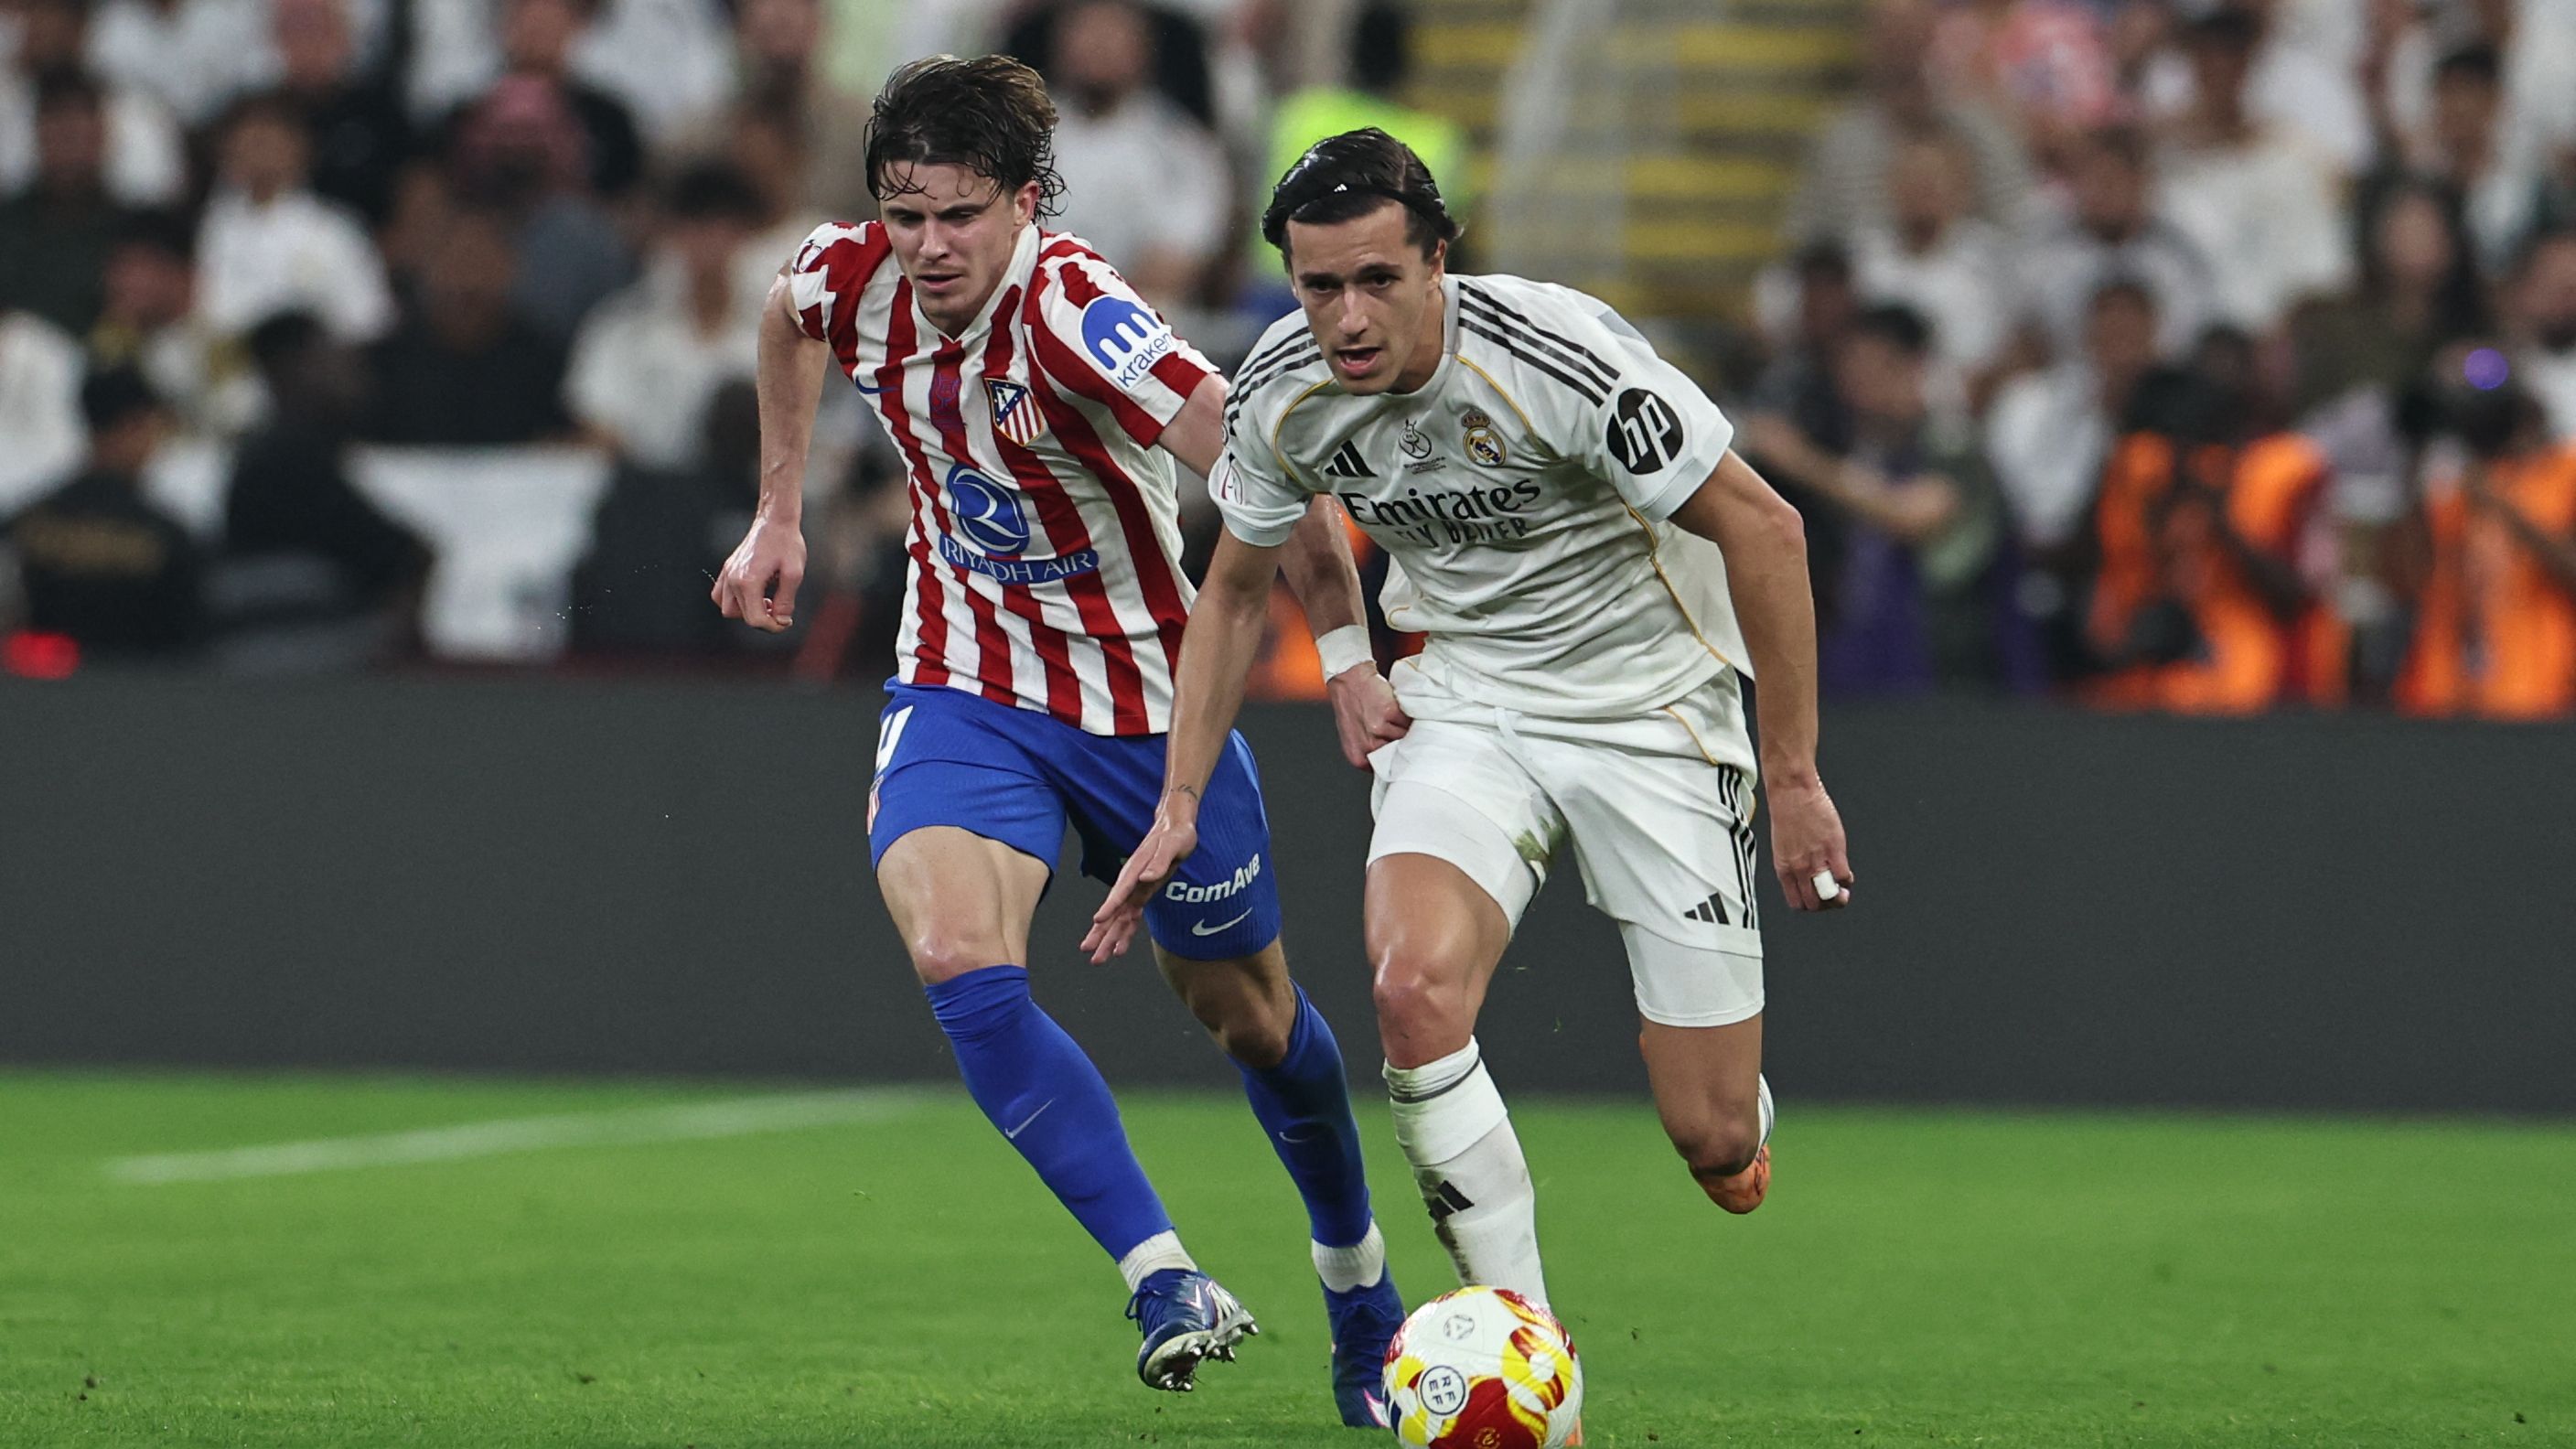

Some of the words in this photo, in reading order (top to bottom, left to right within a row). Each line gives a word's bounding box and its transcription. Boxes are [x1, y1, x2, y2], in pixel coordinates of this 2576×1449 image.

[1117, 332, 1174, 388] kraken
[1610, 392, 1676, 472] hp
[1338, 478, 1541, 527] Emirates
[944, 537, 1035, 583] RIYADH
[1043, 552, 1094, 581] AIR
[1165, 852, 1261, 904] ComAve
